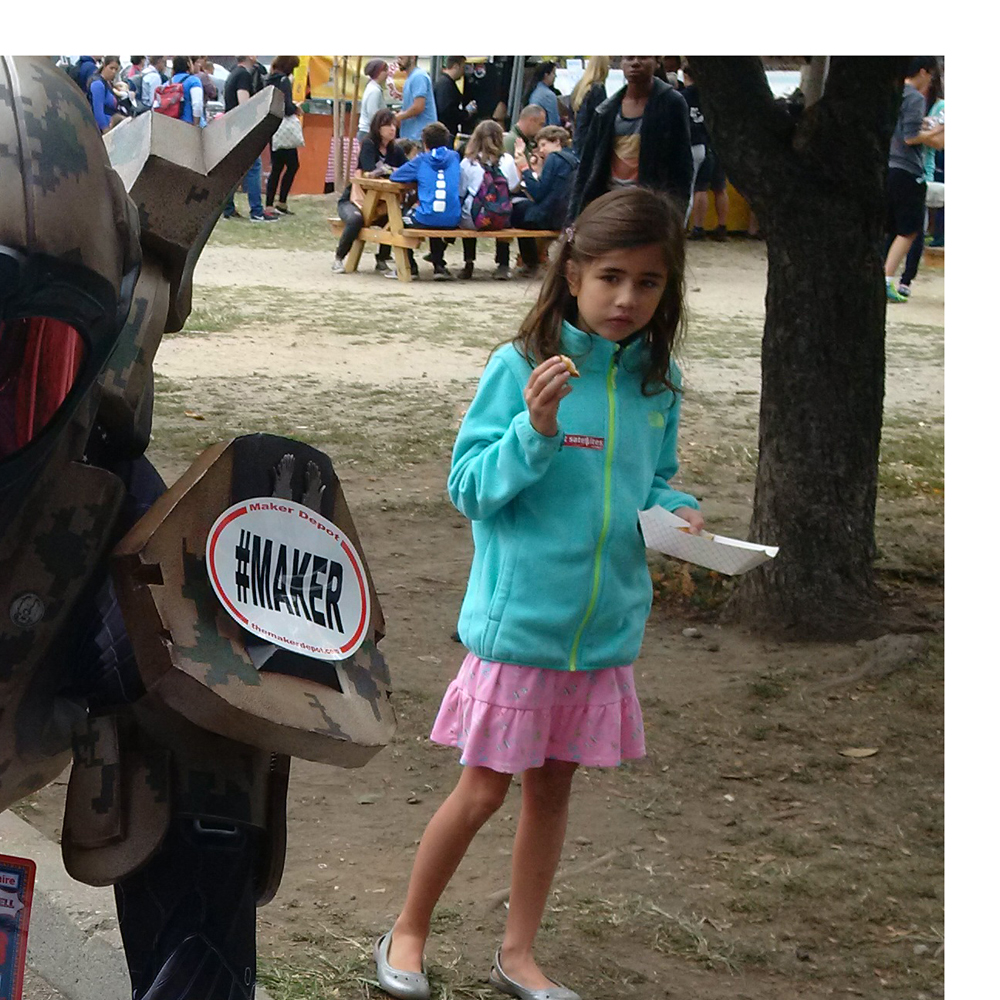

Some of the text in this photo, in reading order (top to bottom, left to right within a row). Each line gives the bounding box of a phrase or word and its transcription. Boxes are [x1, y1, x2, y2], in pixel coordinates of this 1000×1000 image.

[250, 503, 340, 541] Maker Depot
[235, 529, 344, 634] #MAKER
[251, 623, 340, 655] themakerdepot.com
